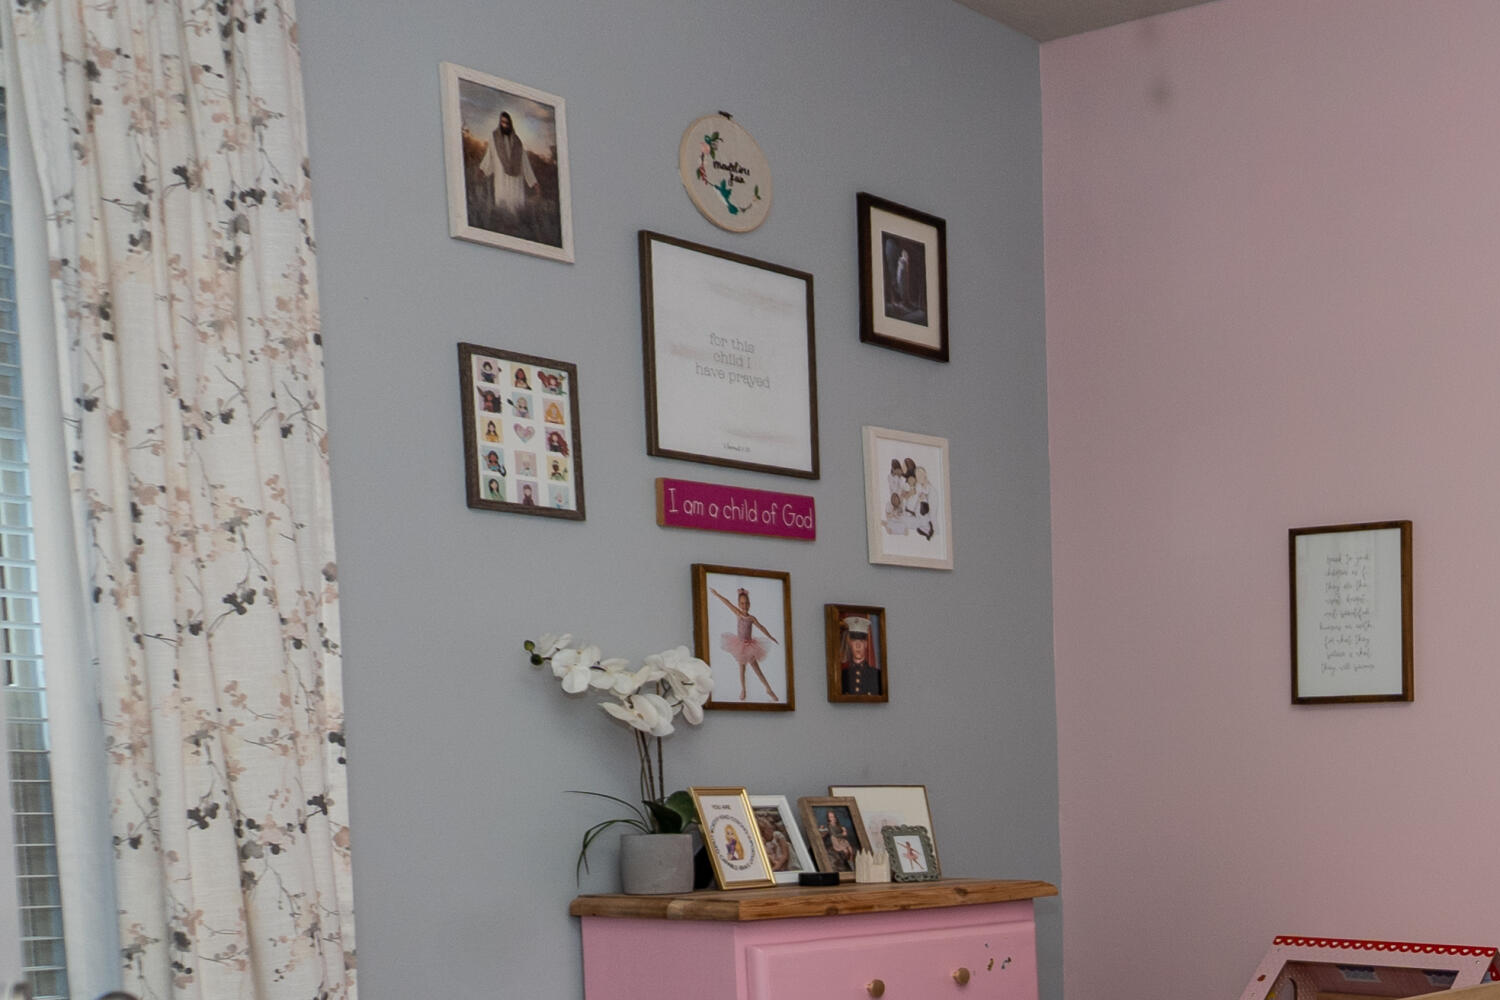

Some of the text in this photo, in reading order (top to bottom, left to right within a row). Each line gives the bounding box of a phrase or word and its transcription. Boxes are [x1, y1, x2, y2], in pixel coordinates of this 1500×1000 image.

[710, 332, 755, 354] for this
[713, 351, 743, 367] child
[696, 362, 769, 389] have prayed
[668, 488, 813, 529] I am a child of God
